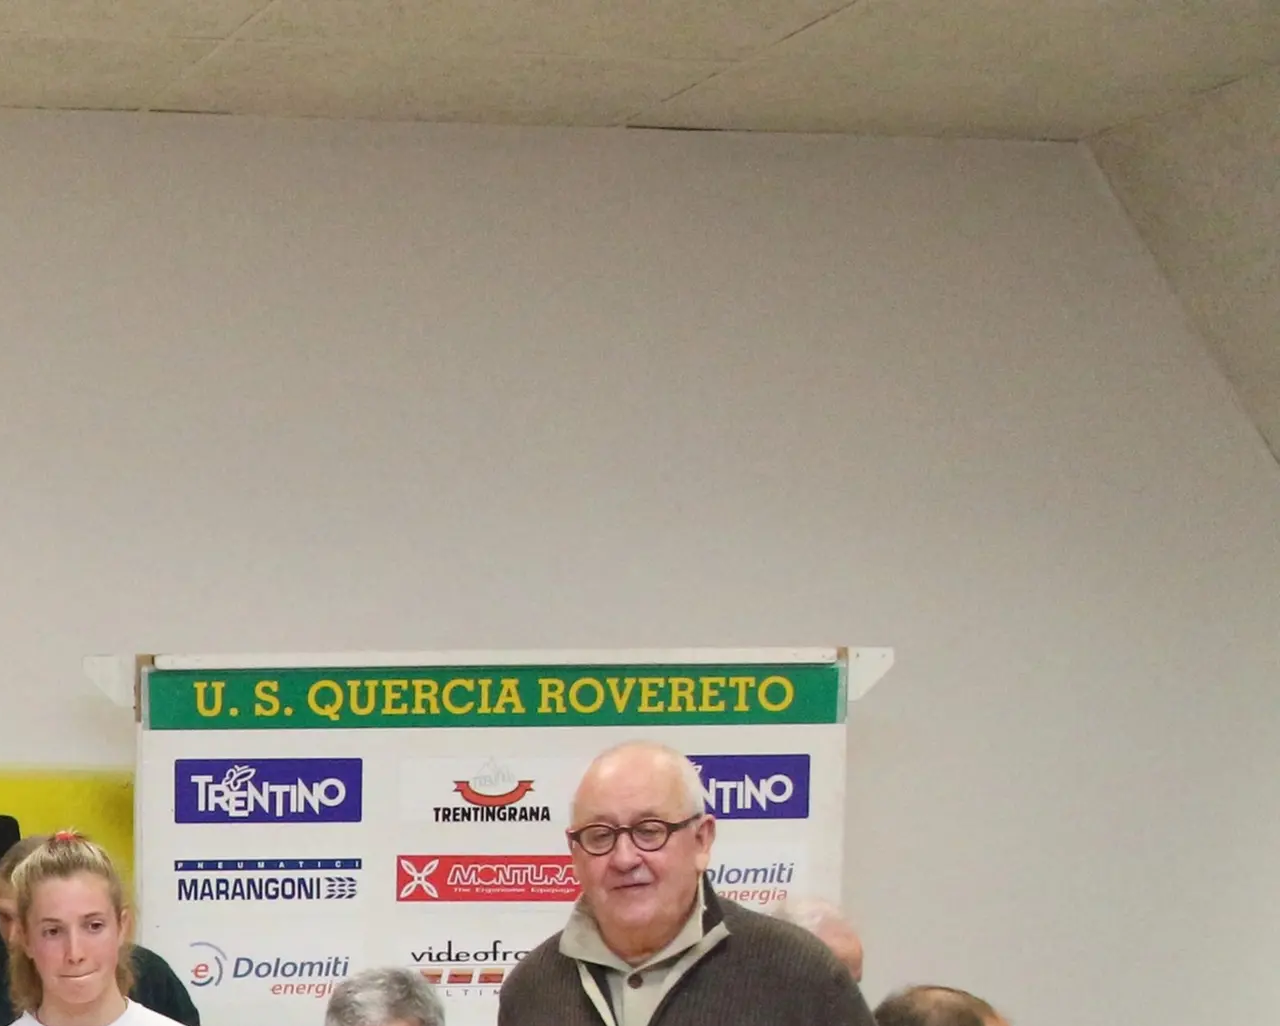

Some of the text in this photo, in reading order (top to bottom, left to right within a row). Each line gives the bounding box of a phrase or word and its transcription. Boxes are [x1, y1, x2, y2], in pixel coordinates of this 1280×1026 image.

[194, 674, 795, 721] U. S. QUERCIA ROVERETO
[190, 774, 347, 817] TRENTINO
[700, 773, 794, 815] NTINO
[433, 805, 551, 823] TRENTINGRANA
[177, 860, 360, 870] PNEUMATICI
[446, 863, 582, 886] MONTURA
[706, 862, 795, 885] olomiti
[177, 877, 322, 901] MARANGONI
[232, 956, 350, 980] Dolomiti
[269, 980, 333, 998] energi
